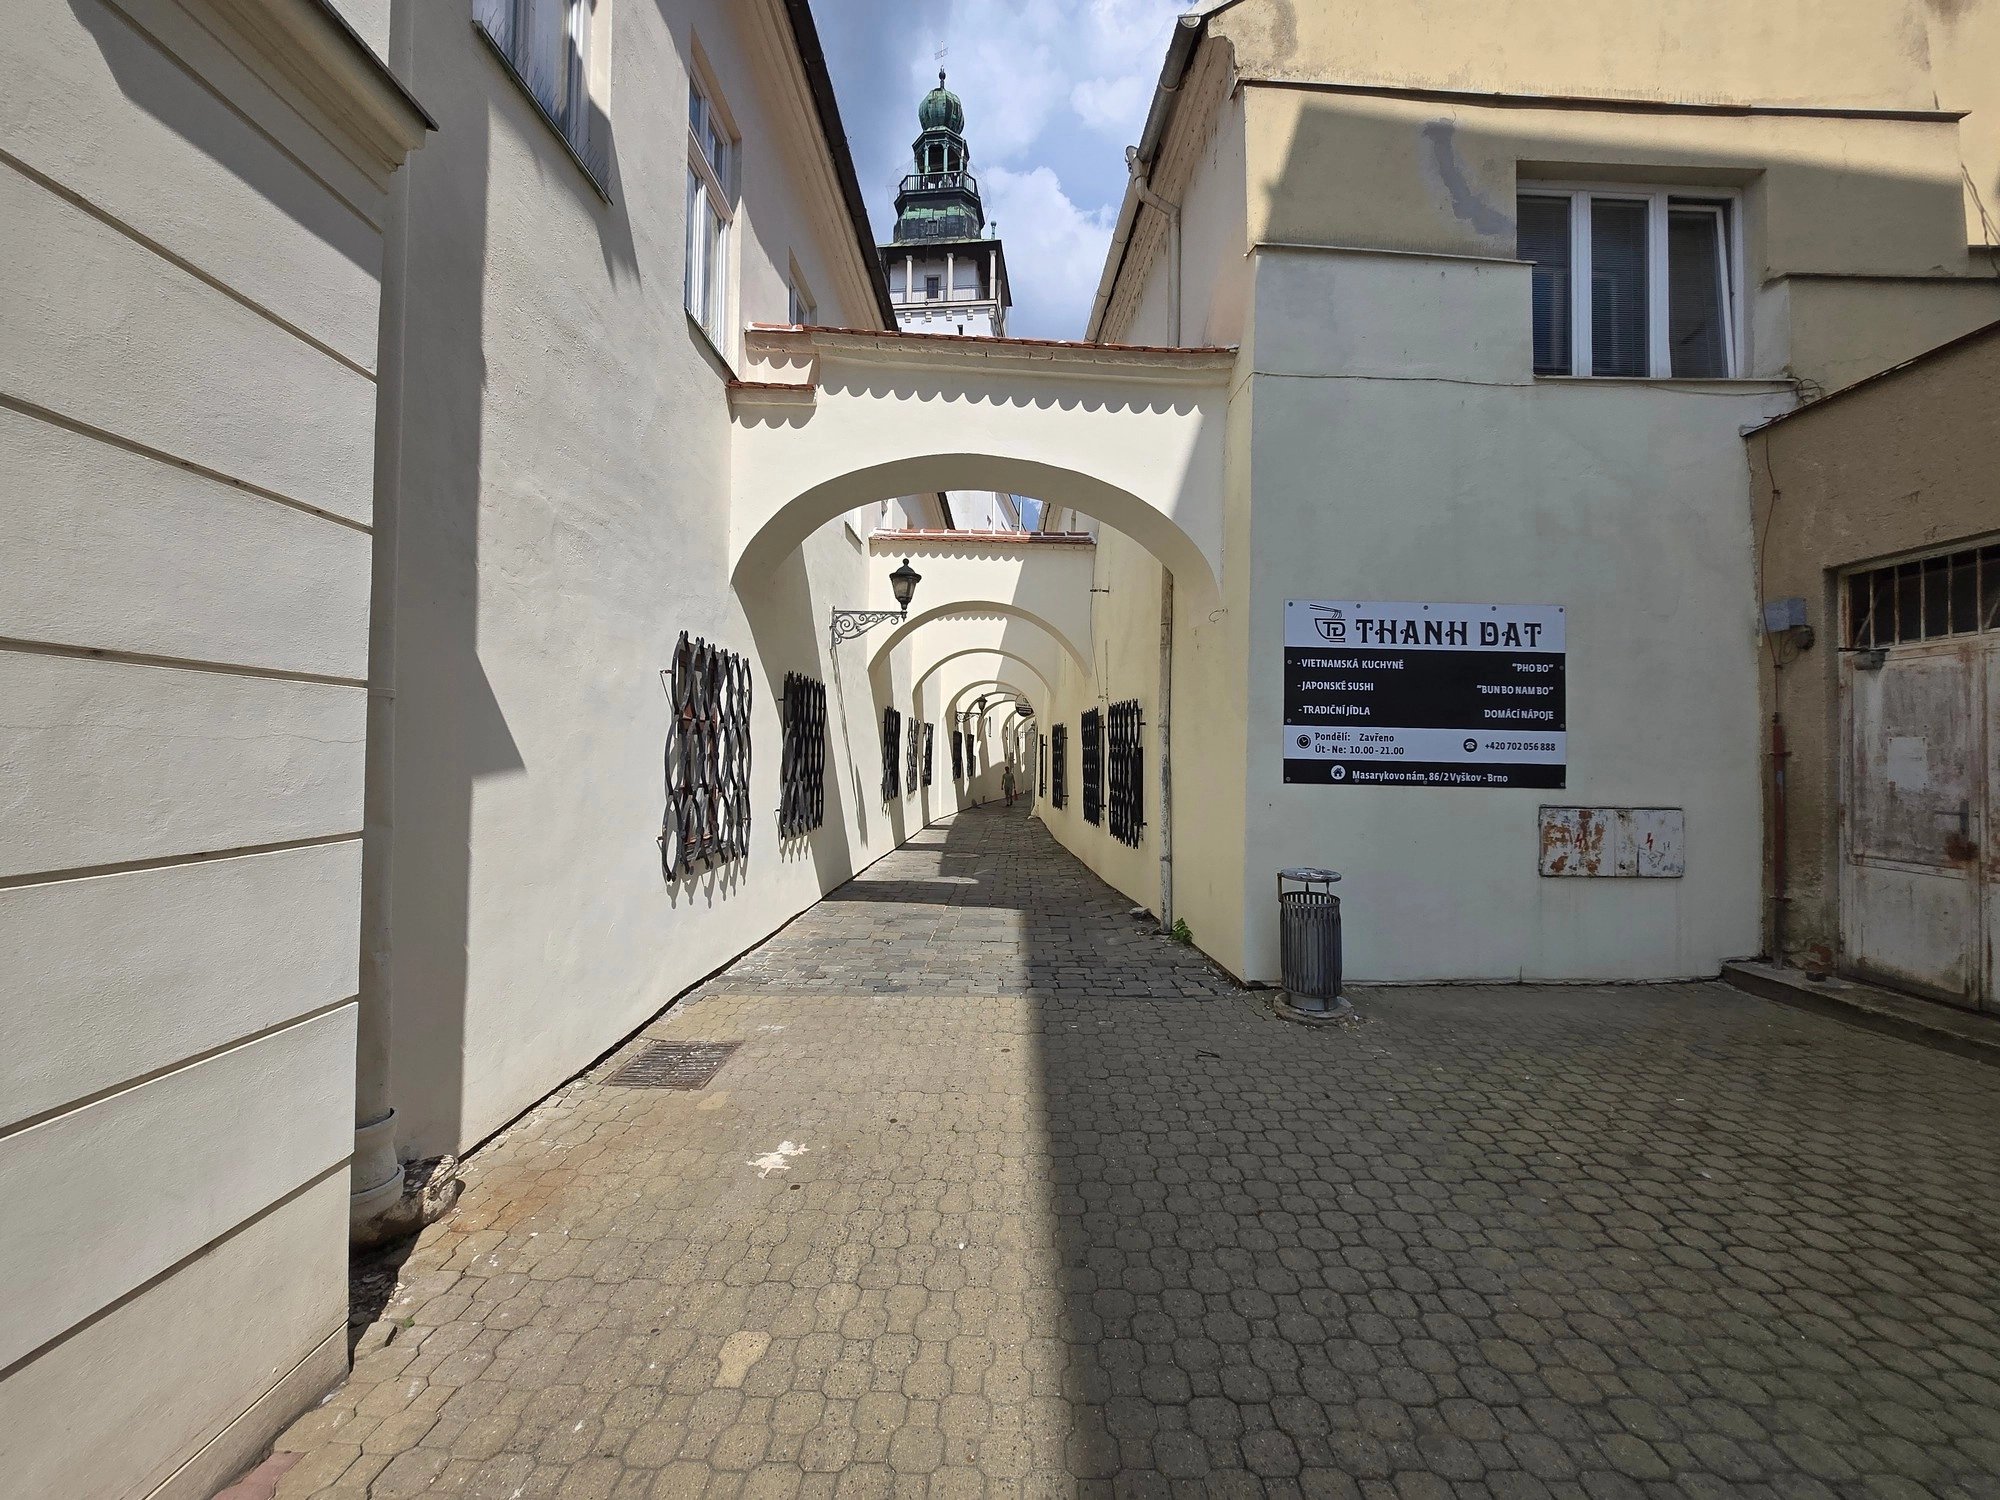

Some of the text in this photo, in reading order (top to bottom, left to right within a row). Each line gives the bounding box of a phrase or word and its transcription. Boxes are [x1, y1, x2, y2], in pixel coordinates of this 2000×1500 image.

[1356, 619, 1542, 647] THANH DAT
[1362, 659, 1404, 669] KUCHYNĚ
[1348, 682, 1374, 690] SUSHI
[1502, 686, 1513, 694] BO
[1346, 705, 1370, 716] JÍDLA
[1484, 708, 1553, 720] DOMÁCÍ NÁPOJE
[1315, 732, 1394, 742] Pondělí: Zavřeno
[1350, 746, 1373, 754] 10.00
[1380, 747, 1404, 755] 21.00
[1485, 742, 1505, 750] +420
[1524, 743, 1538, 751] 056
[1541, 743, 1555, 751] 888
[1353, 770, 1404, 781] Masarykovo
[1406, 771, 1428, 781] nám.
[1429, 773, 1449, 781] 86/2
[1450, 773, 1481, 783] Vyškov
[1488, 774, 1508, 782] Brno
